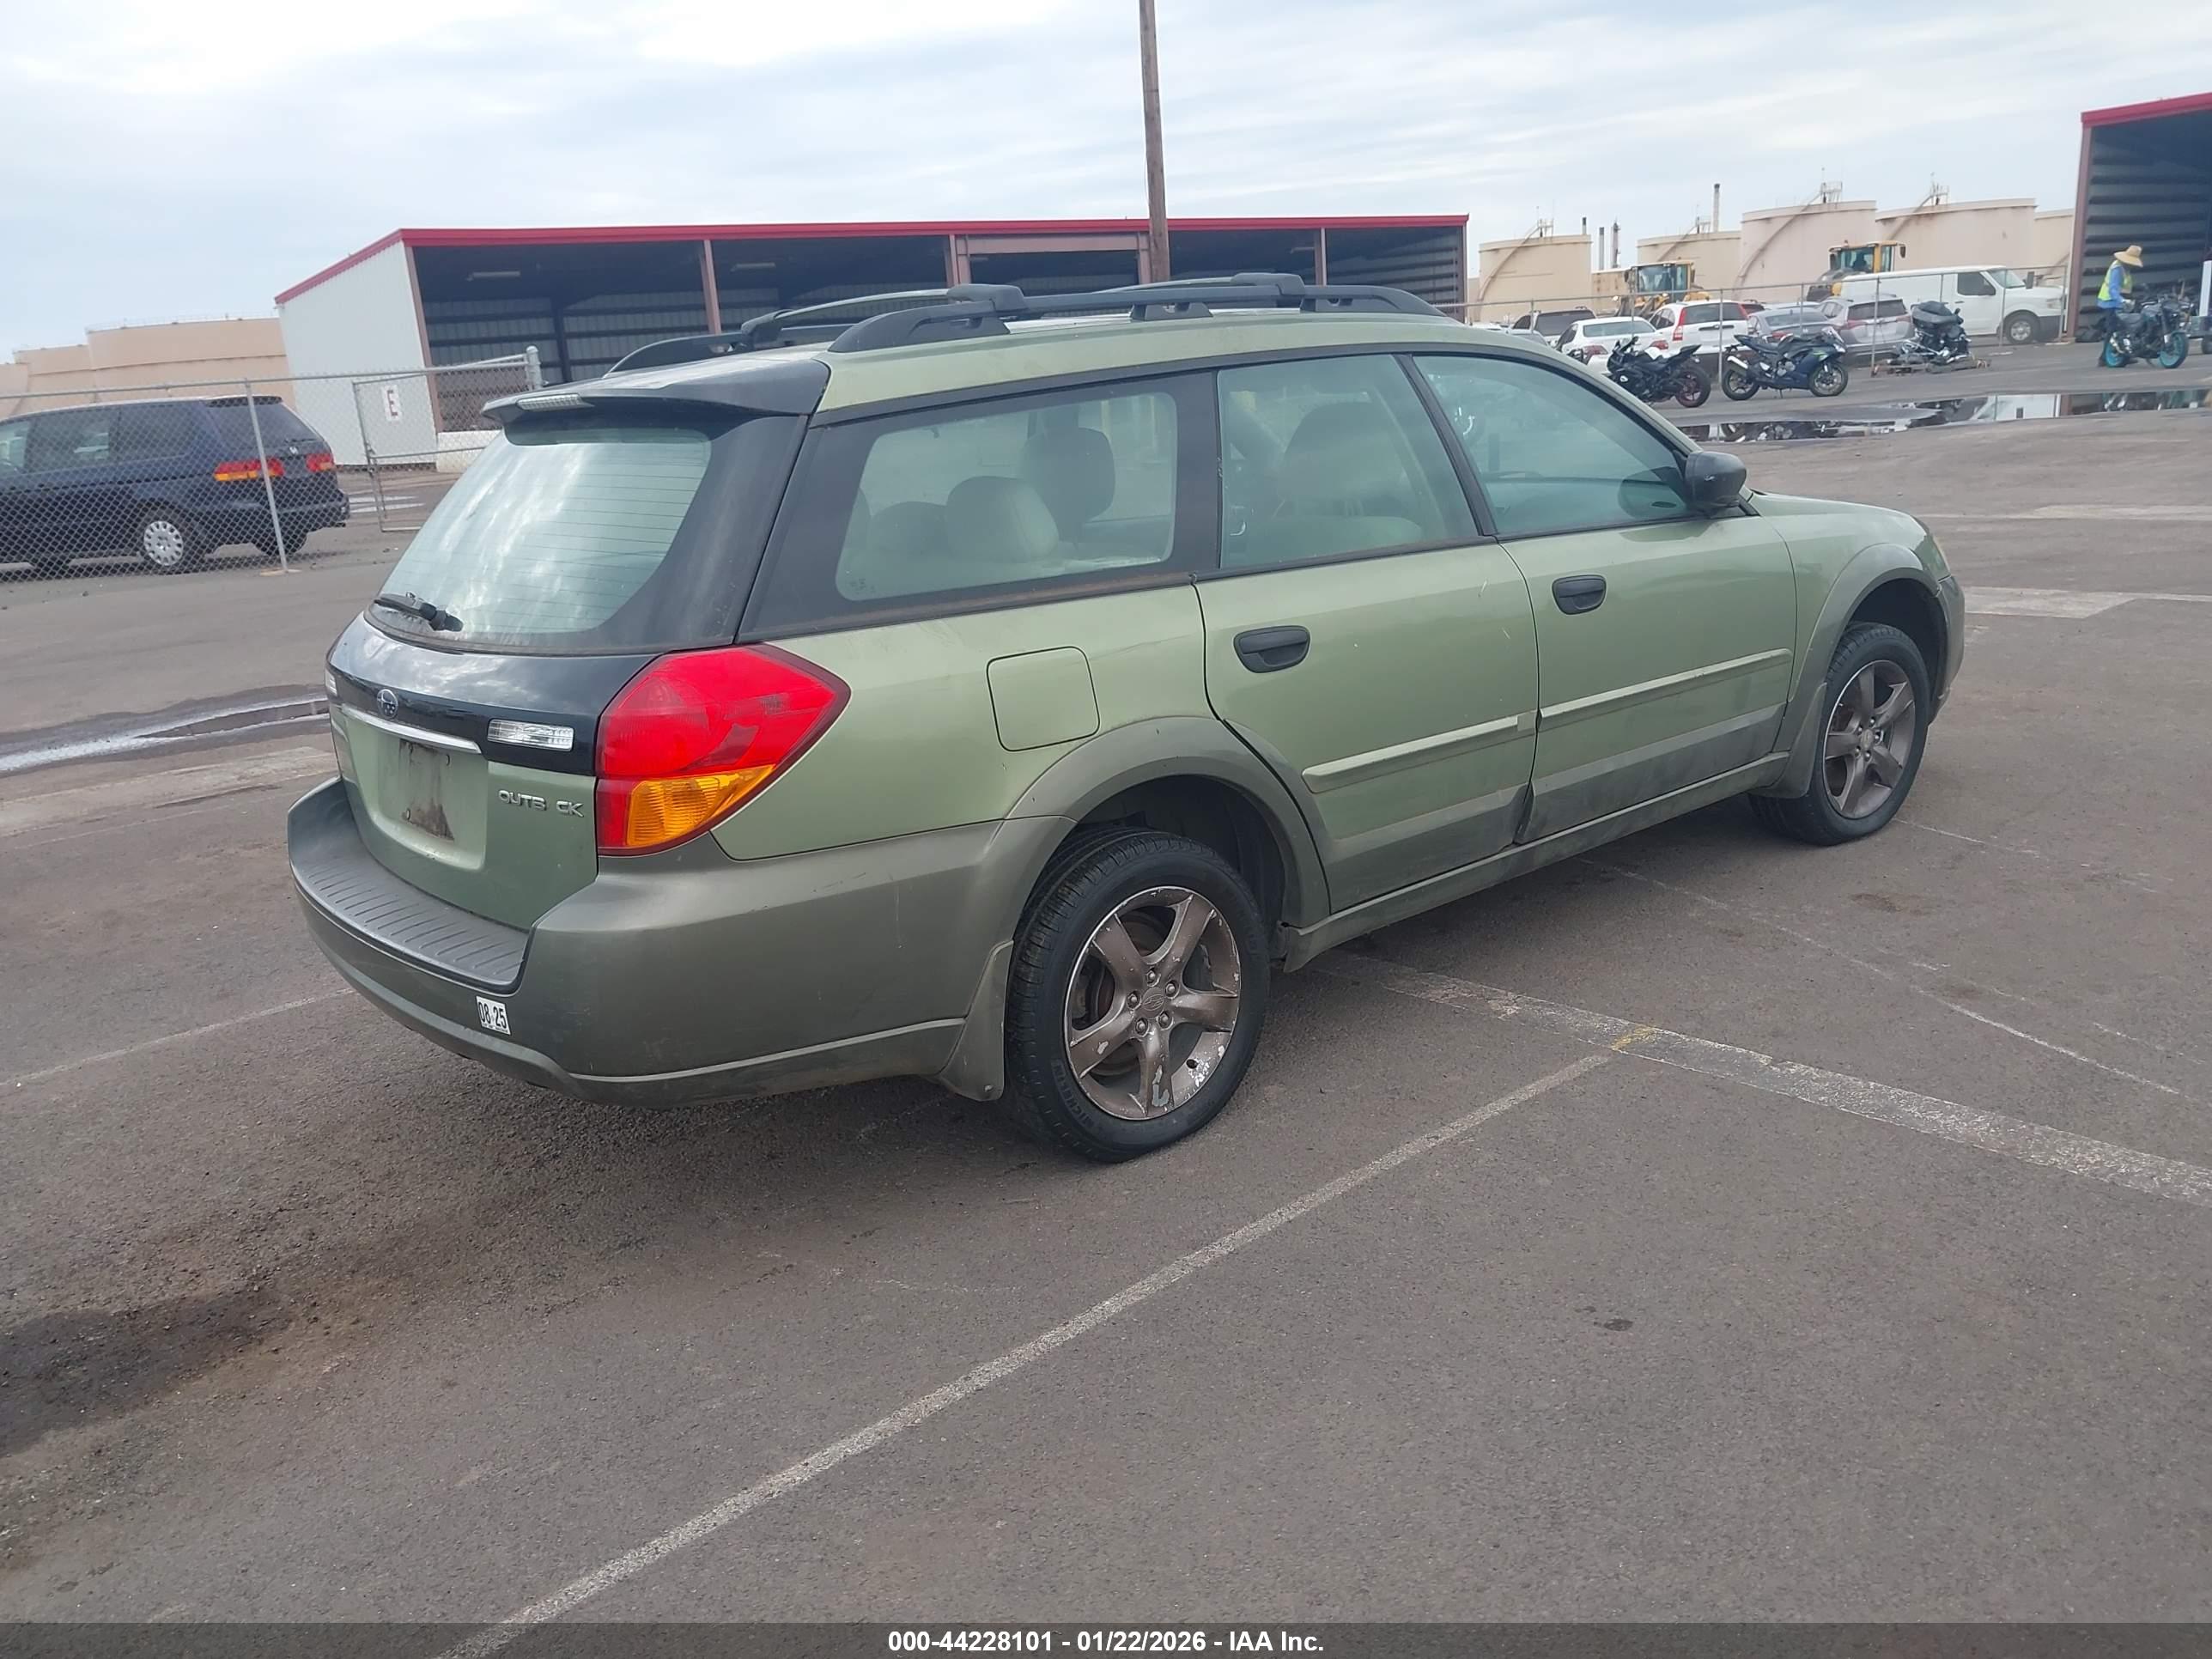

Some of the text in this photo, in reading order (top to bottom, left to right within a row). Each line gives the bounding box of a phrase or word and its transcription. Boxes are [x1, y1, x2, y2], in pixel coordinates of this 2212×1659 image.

[386, 389, 398, 416] E
[477, 1001, 491, 1024] 08
[493, 1006, 507, 1030] 25
